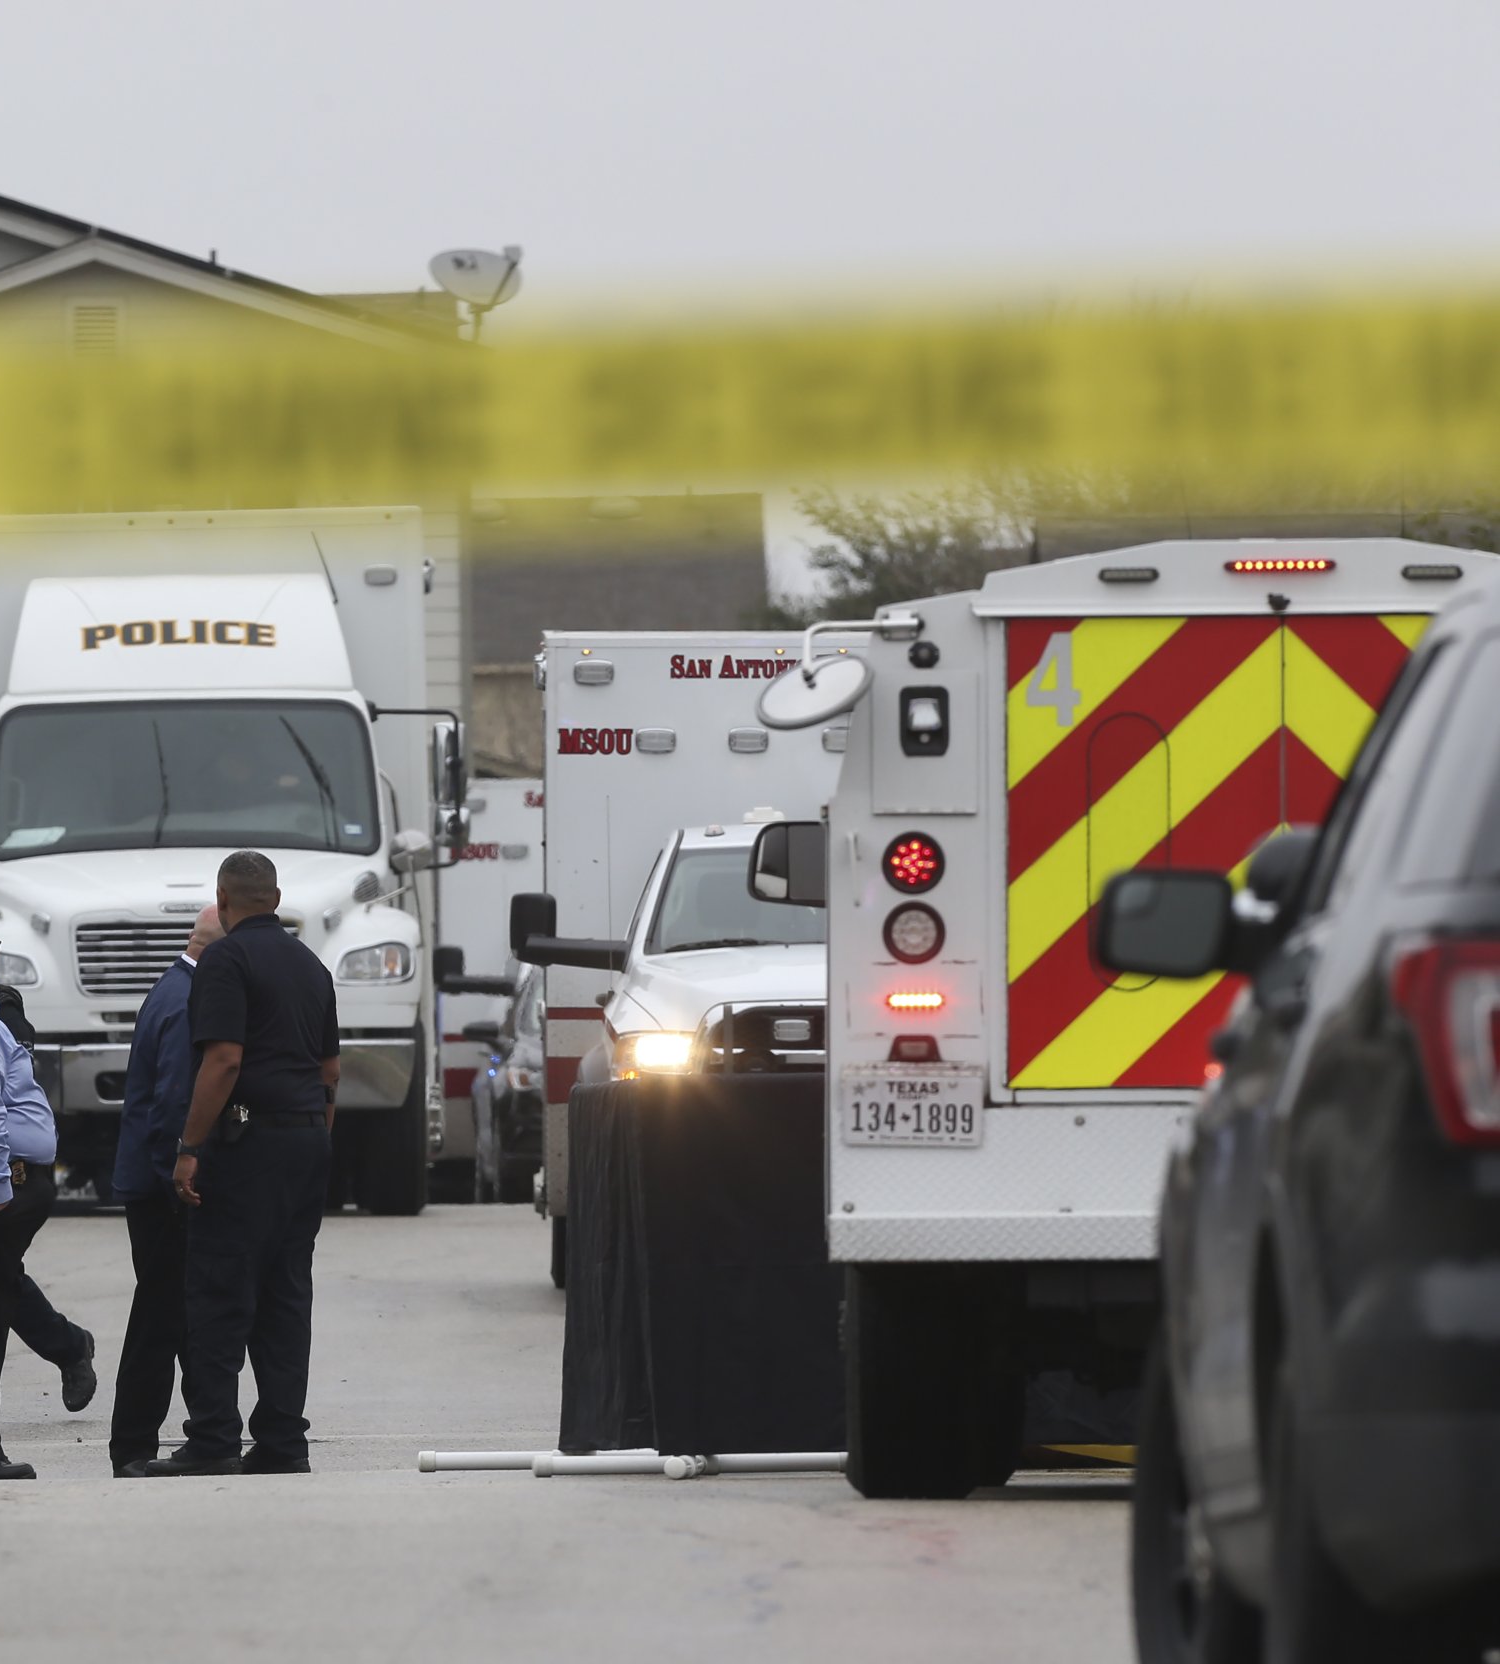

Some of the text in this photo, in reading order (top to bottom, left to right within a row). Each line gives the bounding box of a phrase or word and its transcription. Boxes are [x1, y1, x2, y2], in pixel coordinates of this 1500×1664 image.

[81, 620, 276, 650] POLICE
[670, 655, 712, 679] SAN
[1026, 632, 1082, 726] 4
[558, 728, 633, 755] MSOU
[887, 1081, 940, 1094] TEXAS
